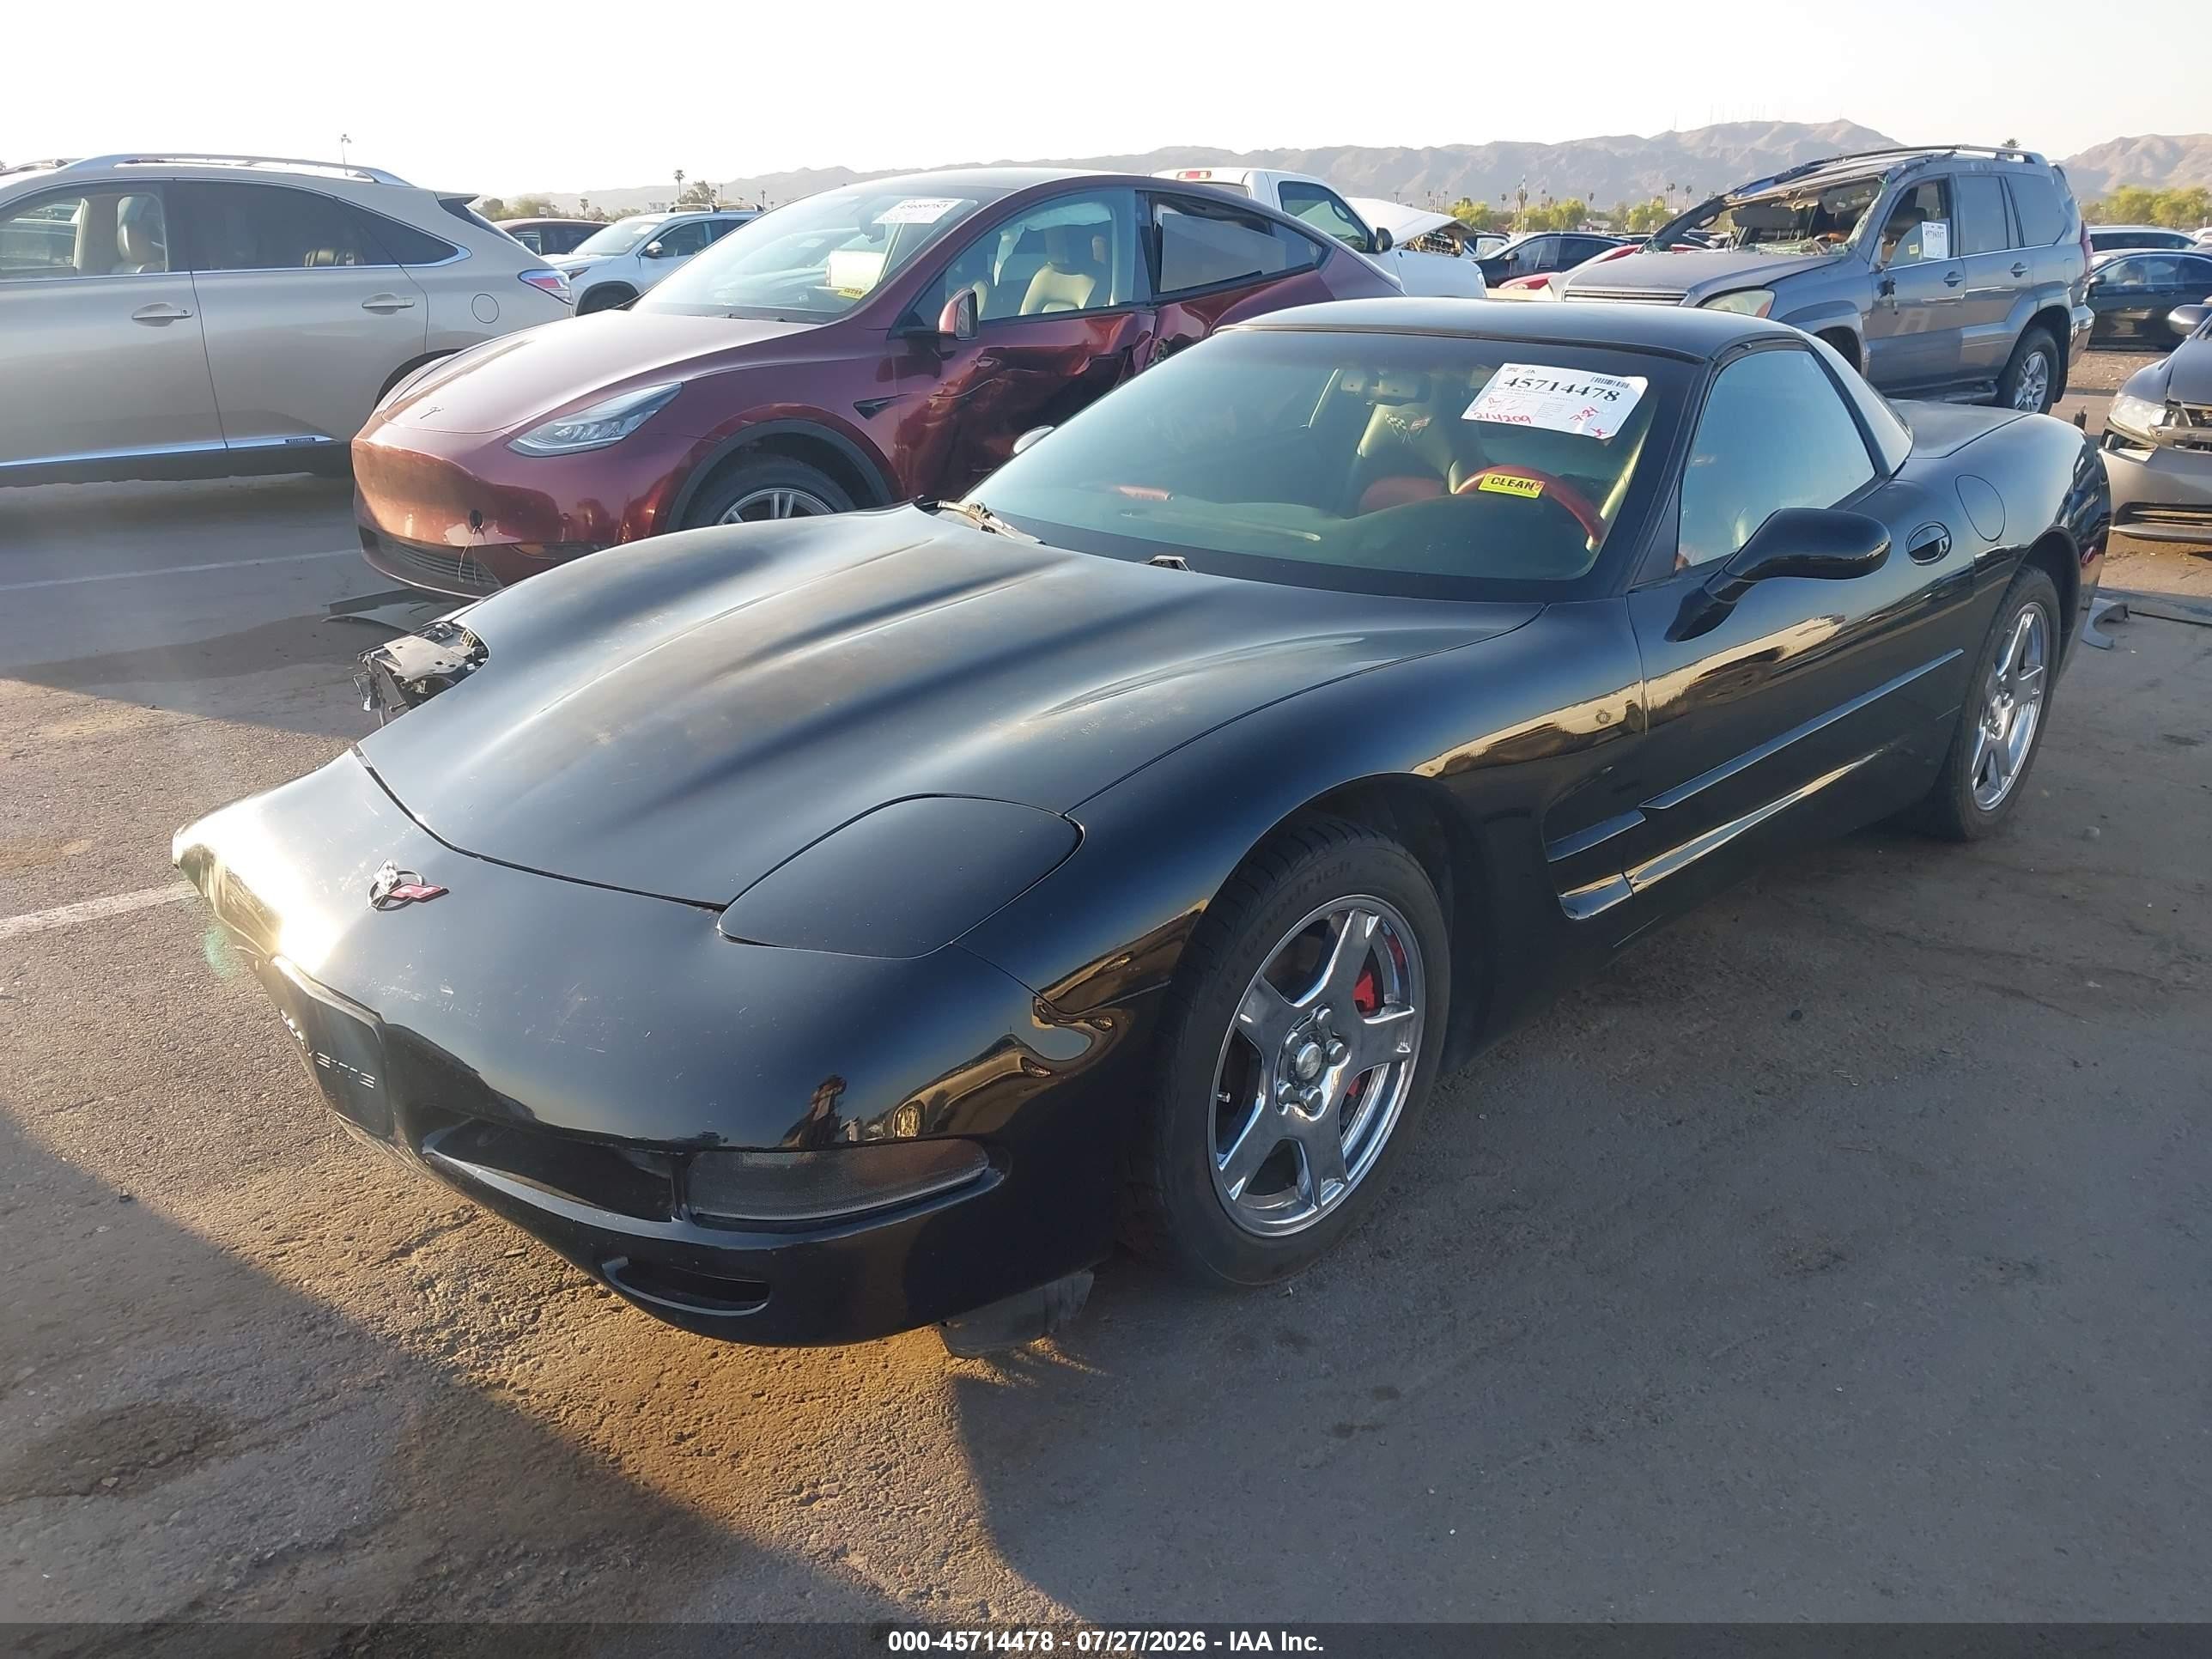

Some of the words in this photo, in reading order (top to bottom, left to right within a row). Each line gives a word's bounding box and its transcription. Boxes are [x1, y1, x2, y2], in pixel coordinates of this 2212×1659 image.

[1504, 377, 1620, 403] 45714478
[1474, 411, 1531, 424] 214209
[1491, 477, 1535, 491] CLEAN
